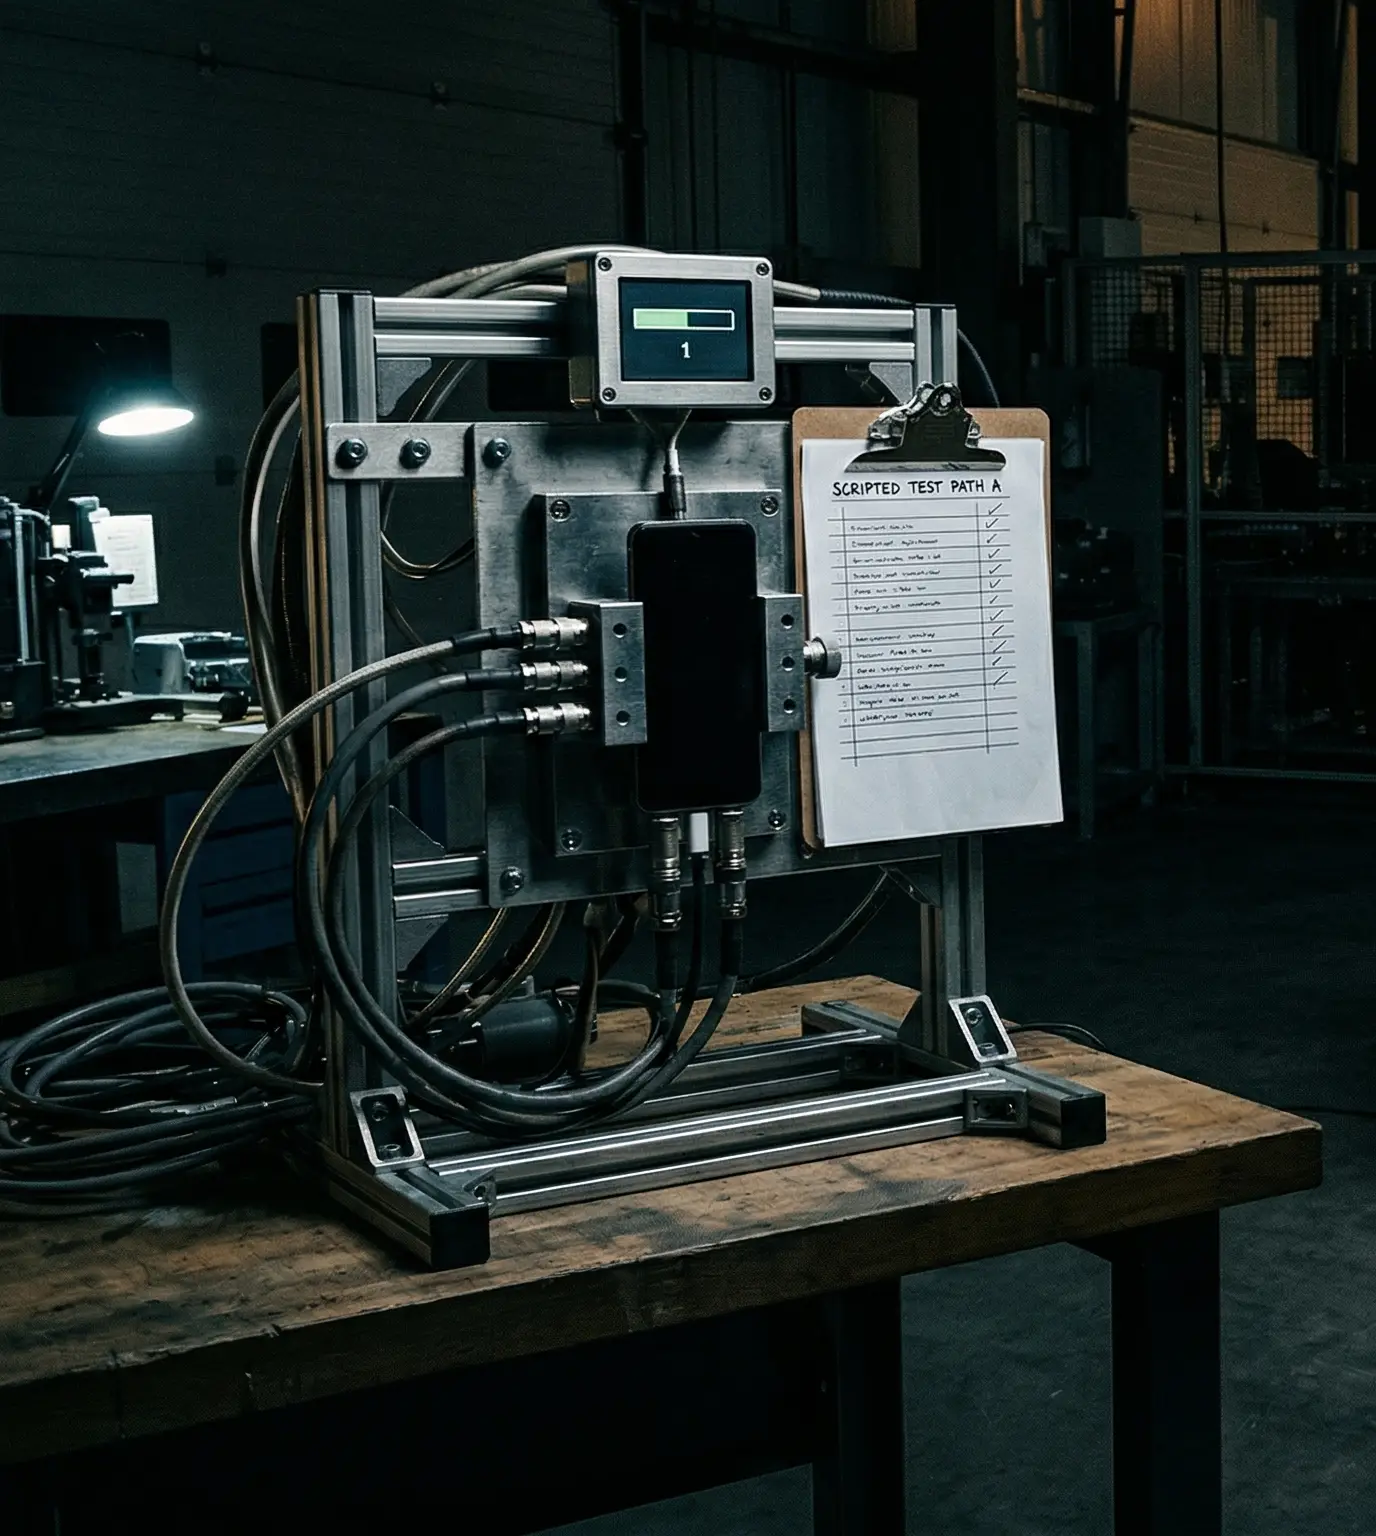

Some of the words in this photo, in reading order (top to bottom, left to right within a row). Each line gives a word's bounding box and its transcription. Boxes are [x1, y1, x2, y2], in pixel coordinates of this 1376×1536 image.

[681, 341, 691, 359] 1
[832, 481, 901, 497] SCRIPTED
[907, 480, 944, 494] TEST
[950, 478, 985, 493] PATH
[991, 478, 1002, 493] A
